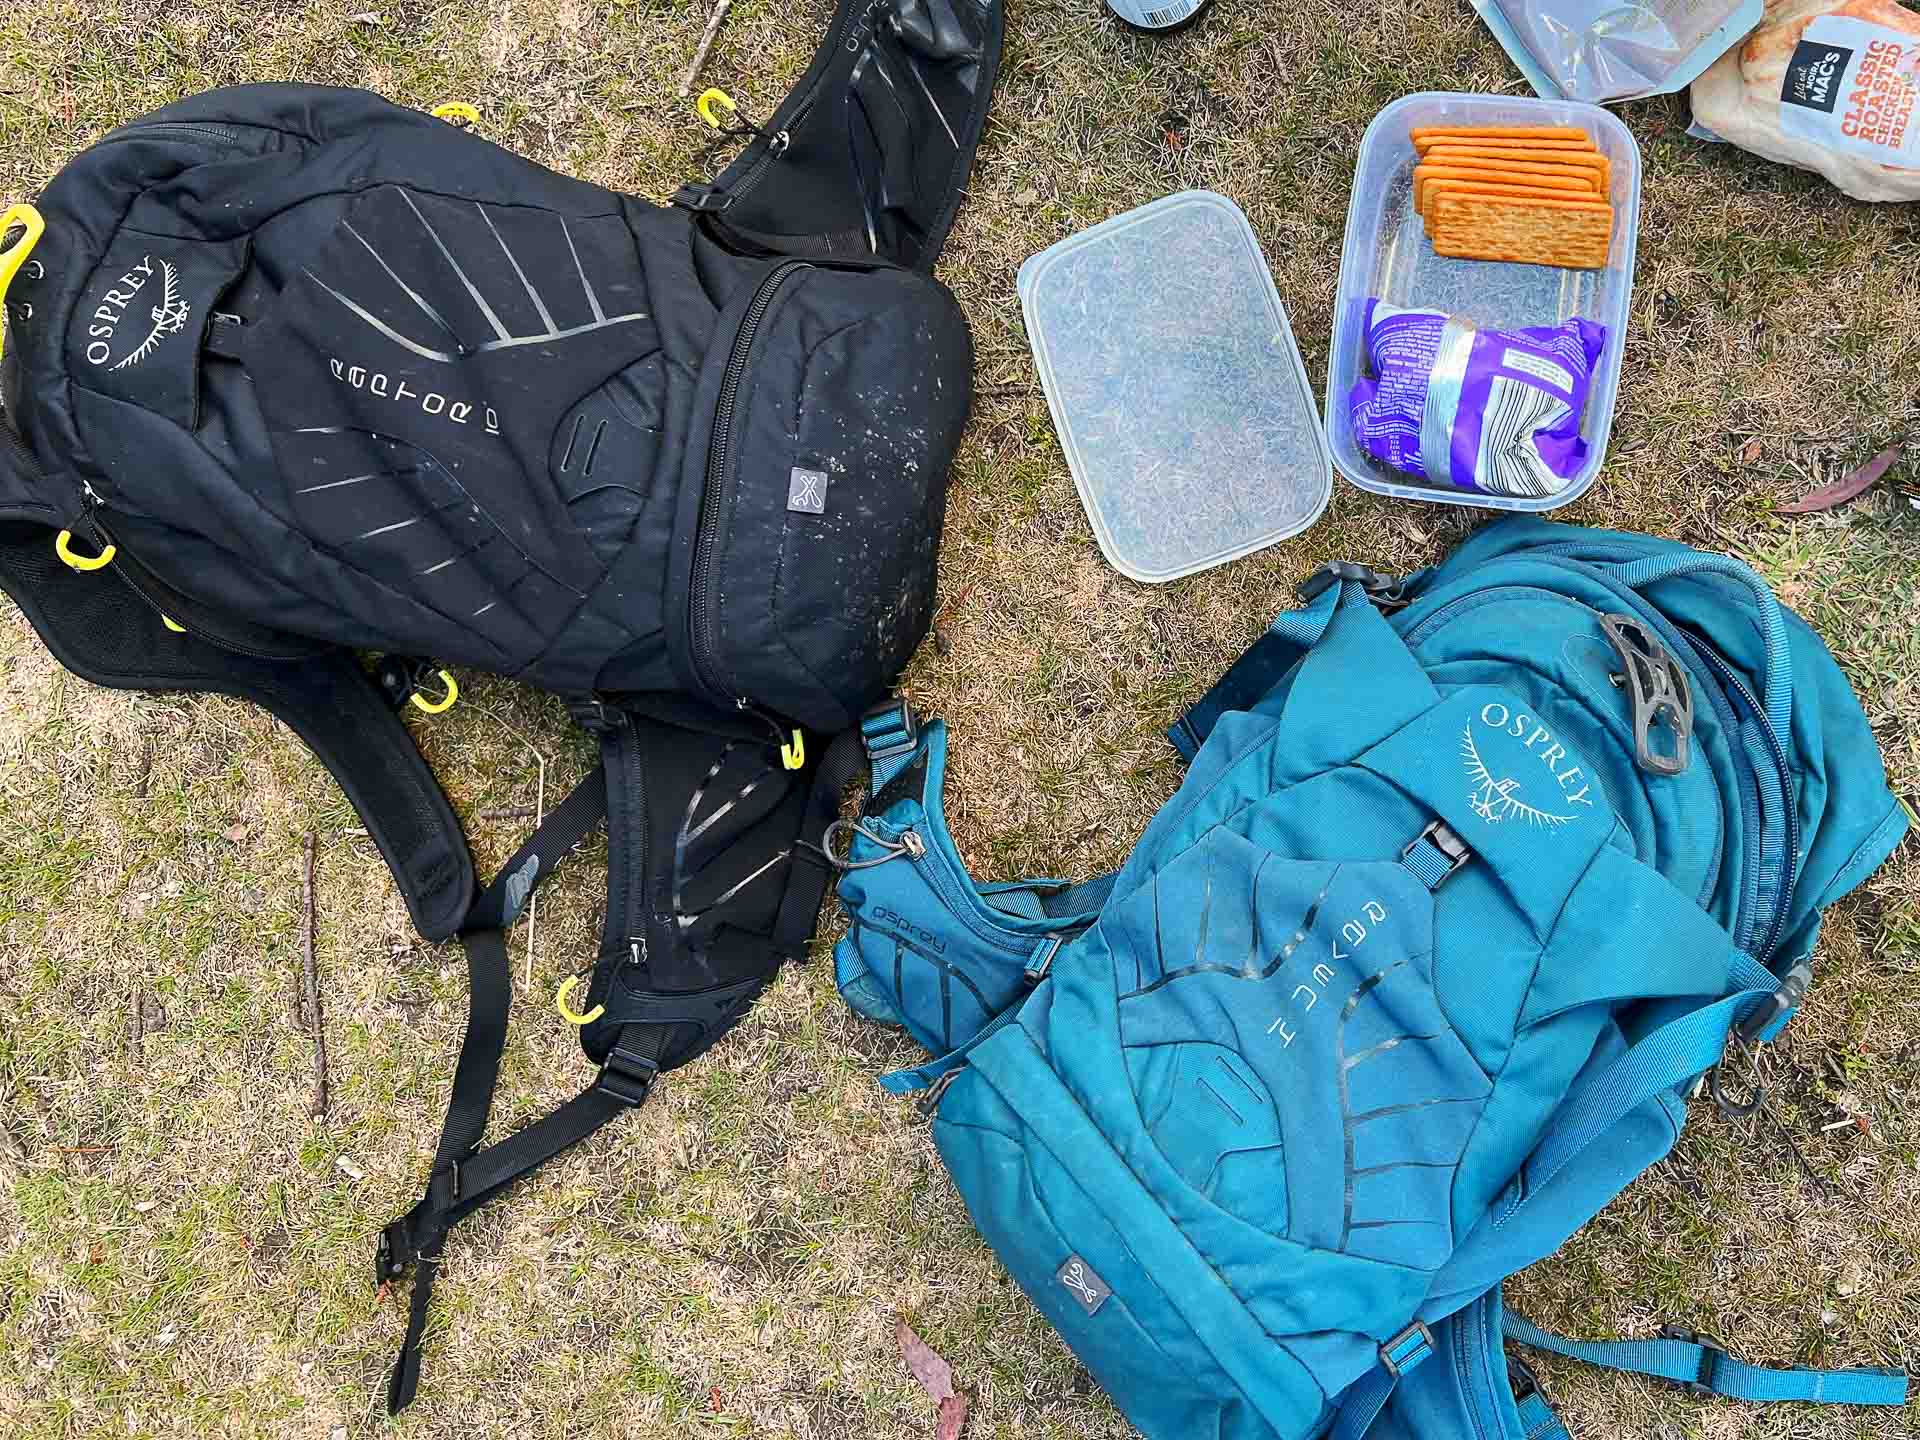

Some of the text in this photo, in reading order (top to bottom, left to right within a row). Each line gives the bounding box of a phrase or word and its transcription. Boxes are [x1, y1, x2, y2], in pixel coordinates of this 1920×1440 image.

[1805, 61, 1821, 89] MOIRA
[1811, 52, 1841, 103] MAC'S
[1841, 40, 1888, 137] CLASSIC
[1859, 43, 1903, 141] ROASTED
[1875, 75, 1902, 145] CHICKEN
[1889, 87, 1916, 149] BREAST
[86, 255, 154, 365] OSPREY
[330, 357, 500, 436] RAPTOR 10
[1481, 703, 1593, 807] OSPREY
[871, 905, 947, 955] osprey
[1267, 1016, 1297, 1049] 14
